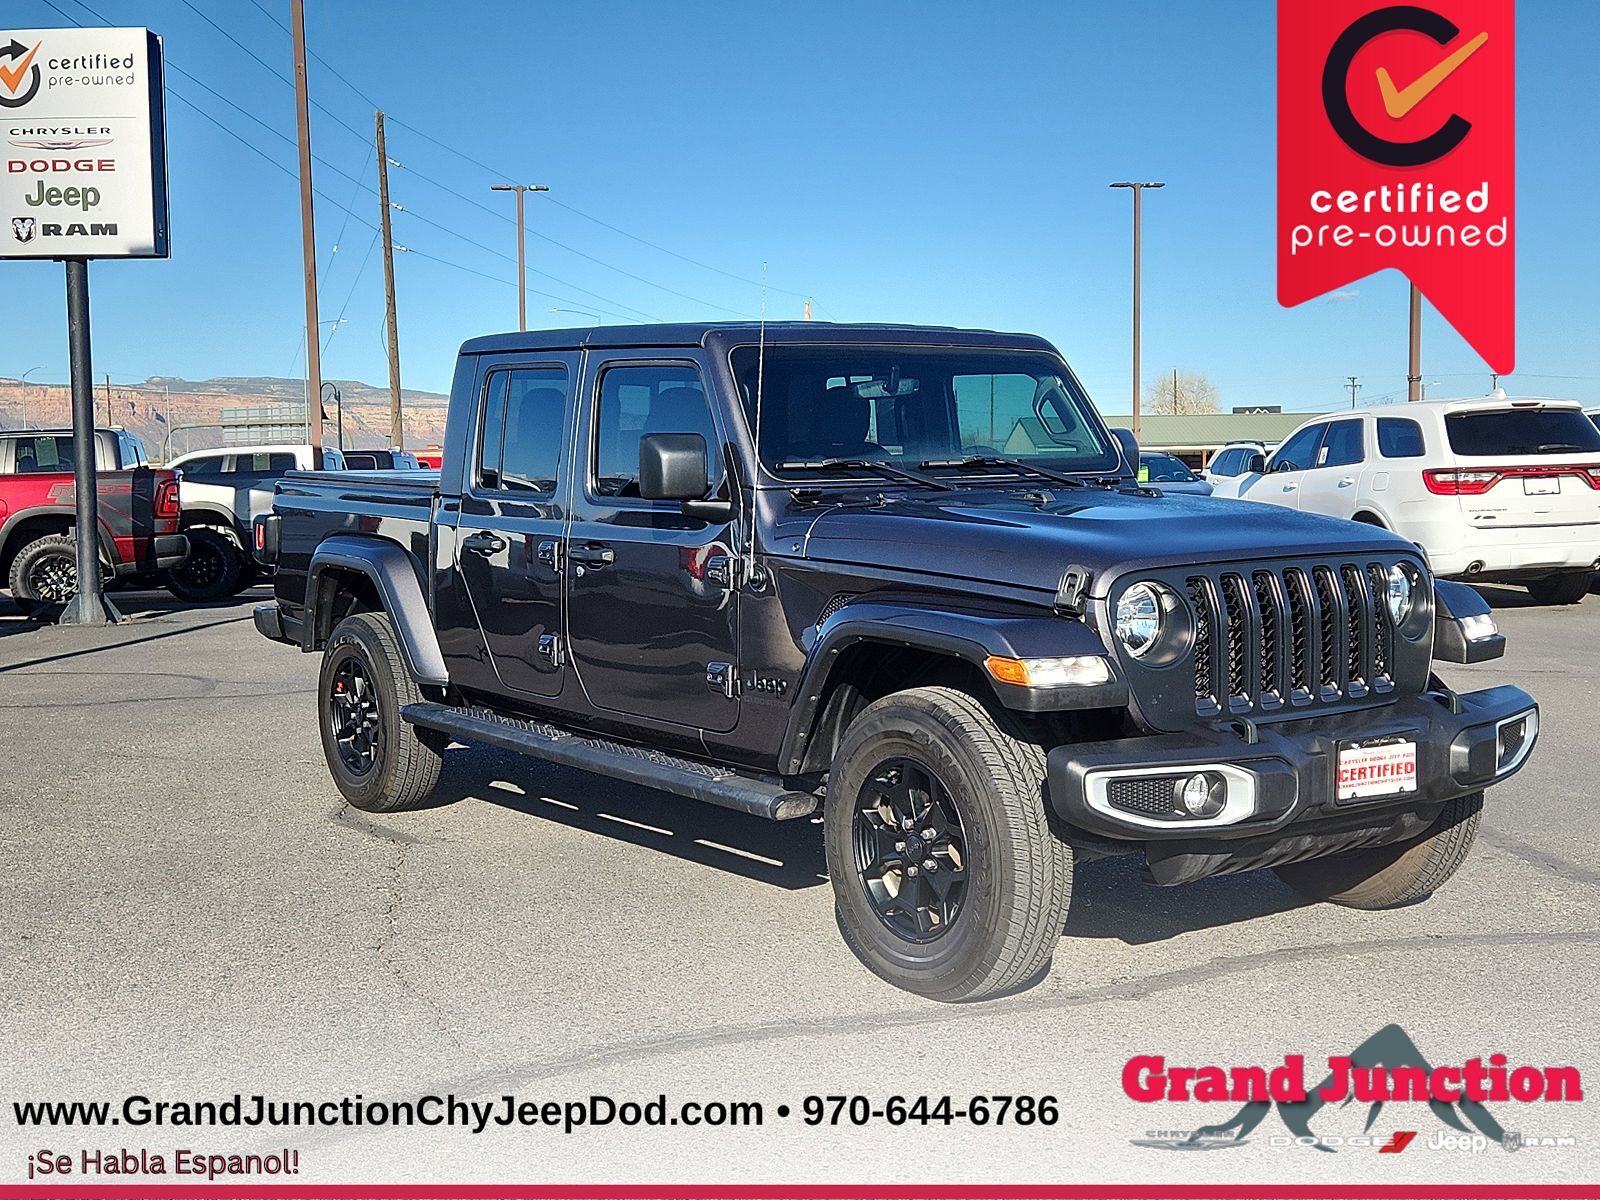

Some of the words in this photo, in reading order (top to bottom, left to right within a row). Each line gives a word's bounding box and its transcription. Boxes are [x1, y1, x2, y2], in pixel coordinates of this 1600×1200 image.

[48, 53, 134, 70] certified
[48, 72, 135, 89] pre-owned
[9, 127, 112, 136] CHRYSLER
[8, 159, 116, 173] DODGE
[25, 180, 101, 211] Jeep
[42, 223, 118, 236] RAM
[746, 669, 788, 698] Jeep
[1338, 761, 1415, 782] CERTIFIED
